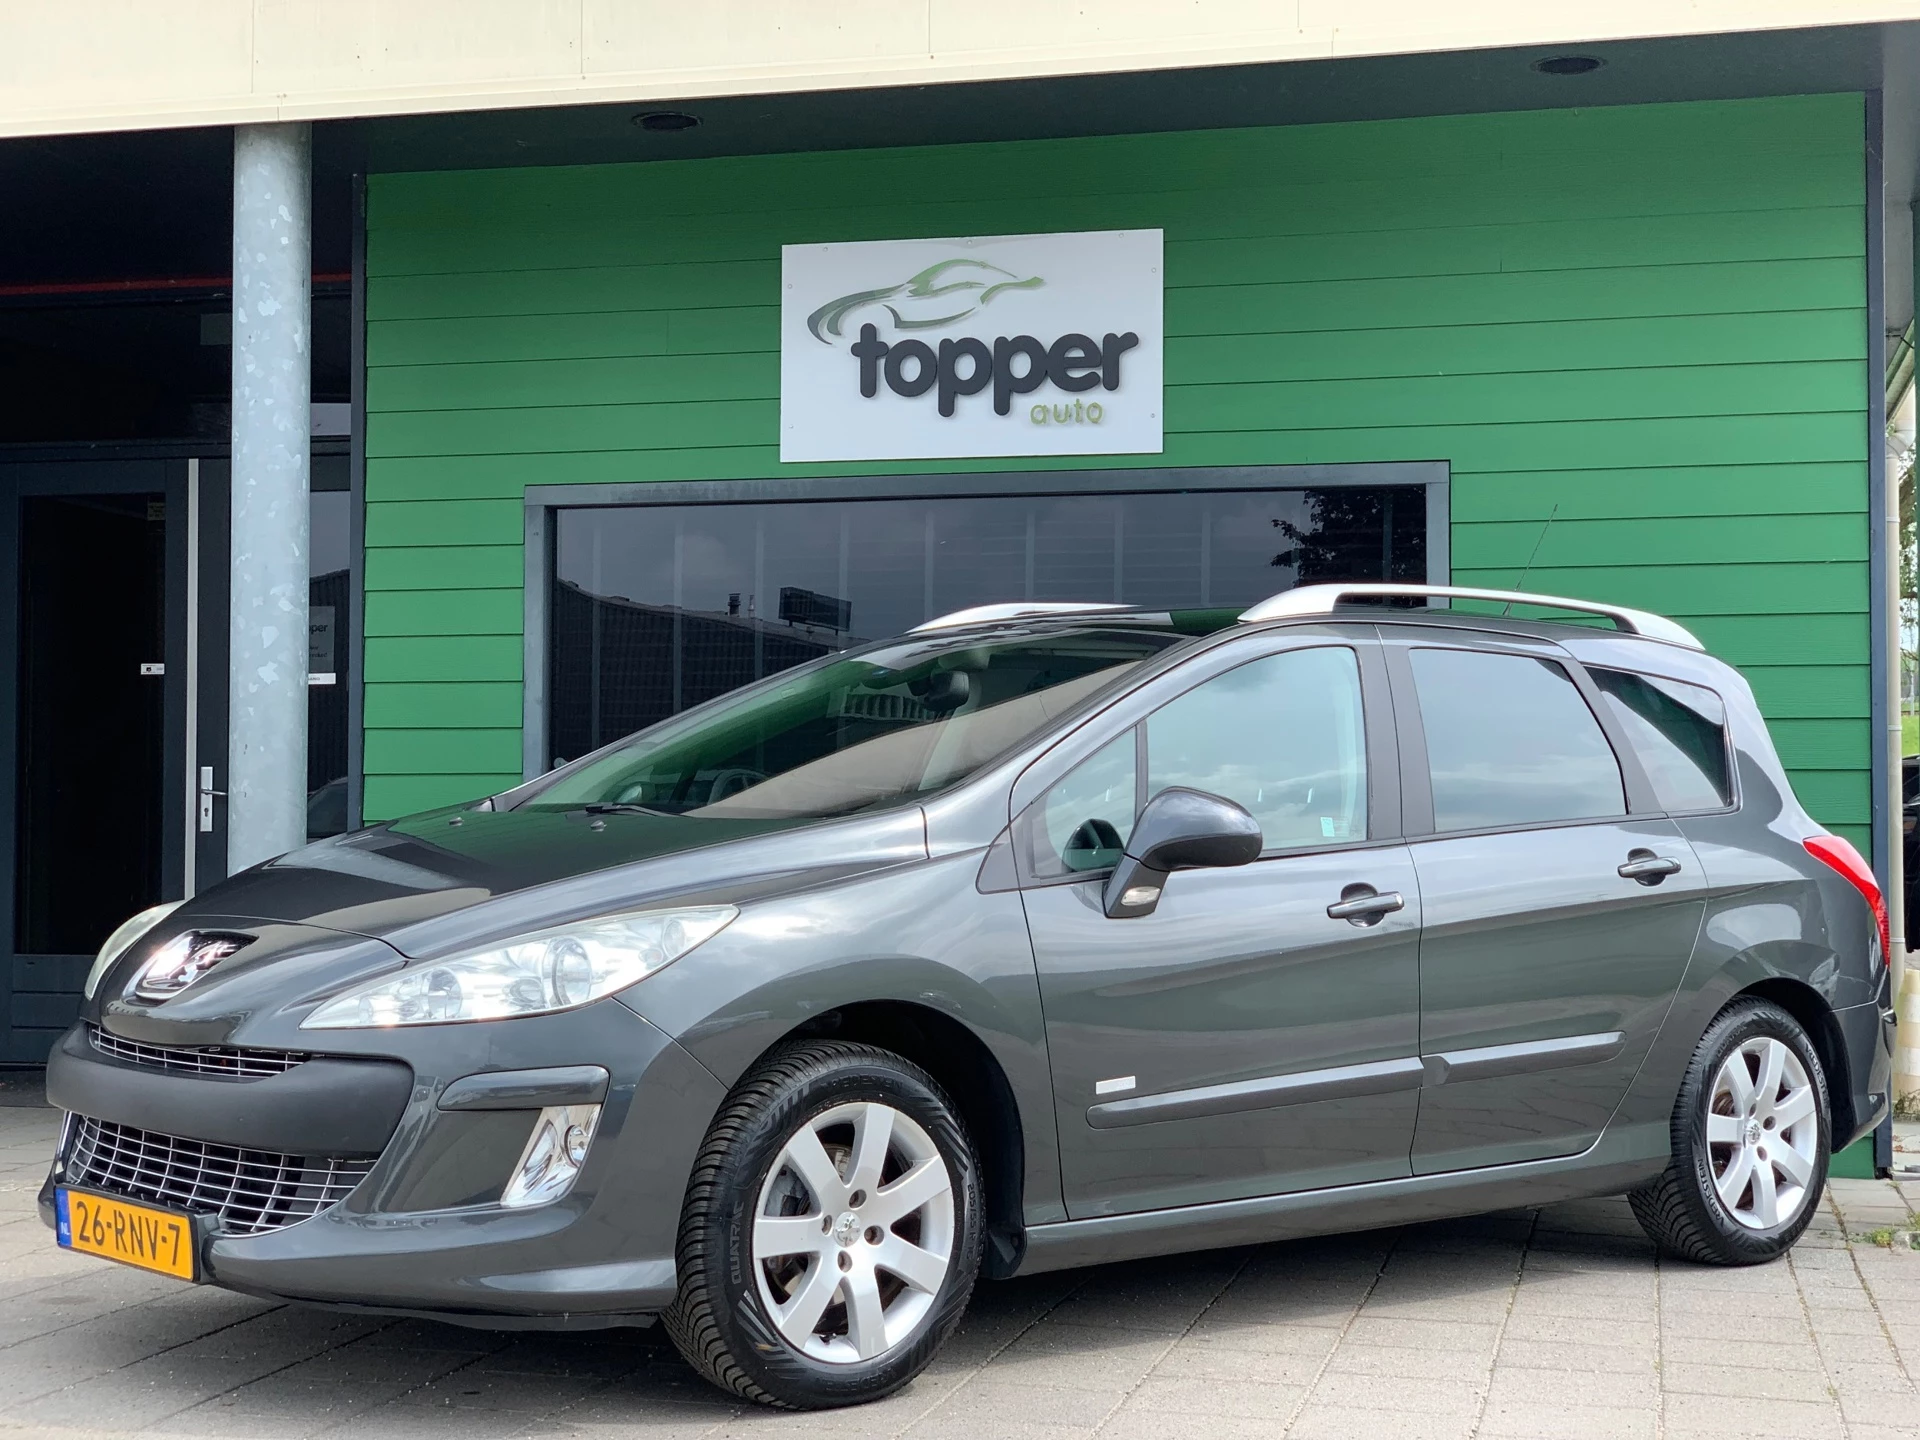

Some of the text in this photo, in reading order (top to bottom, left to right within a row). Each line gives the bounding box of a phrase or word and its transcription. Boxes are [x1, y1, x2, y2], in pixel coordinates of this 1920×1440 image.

[850, 322, 1139, 417] topper
[1030, 398, 1103, 425] auto
[1697, 1158, 1725, 1228] VREDESTEIN
[60, 1200, 181, 1267] NL 26-RNV-7
[730, 1200, 744, 1285] QUATRAC
